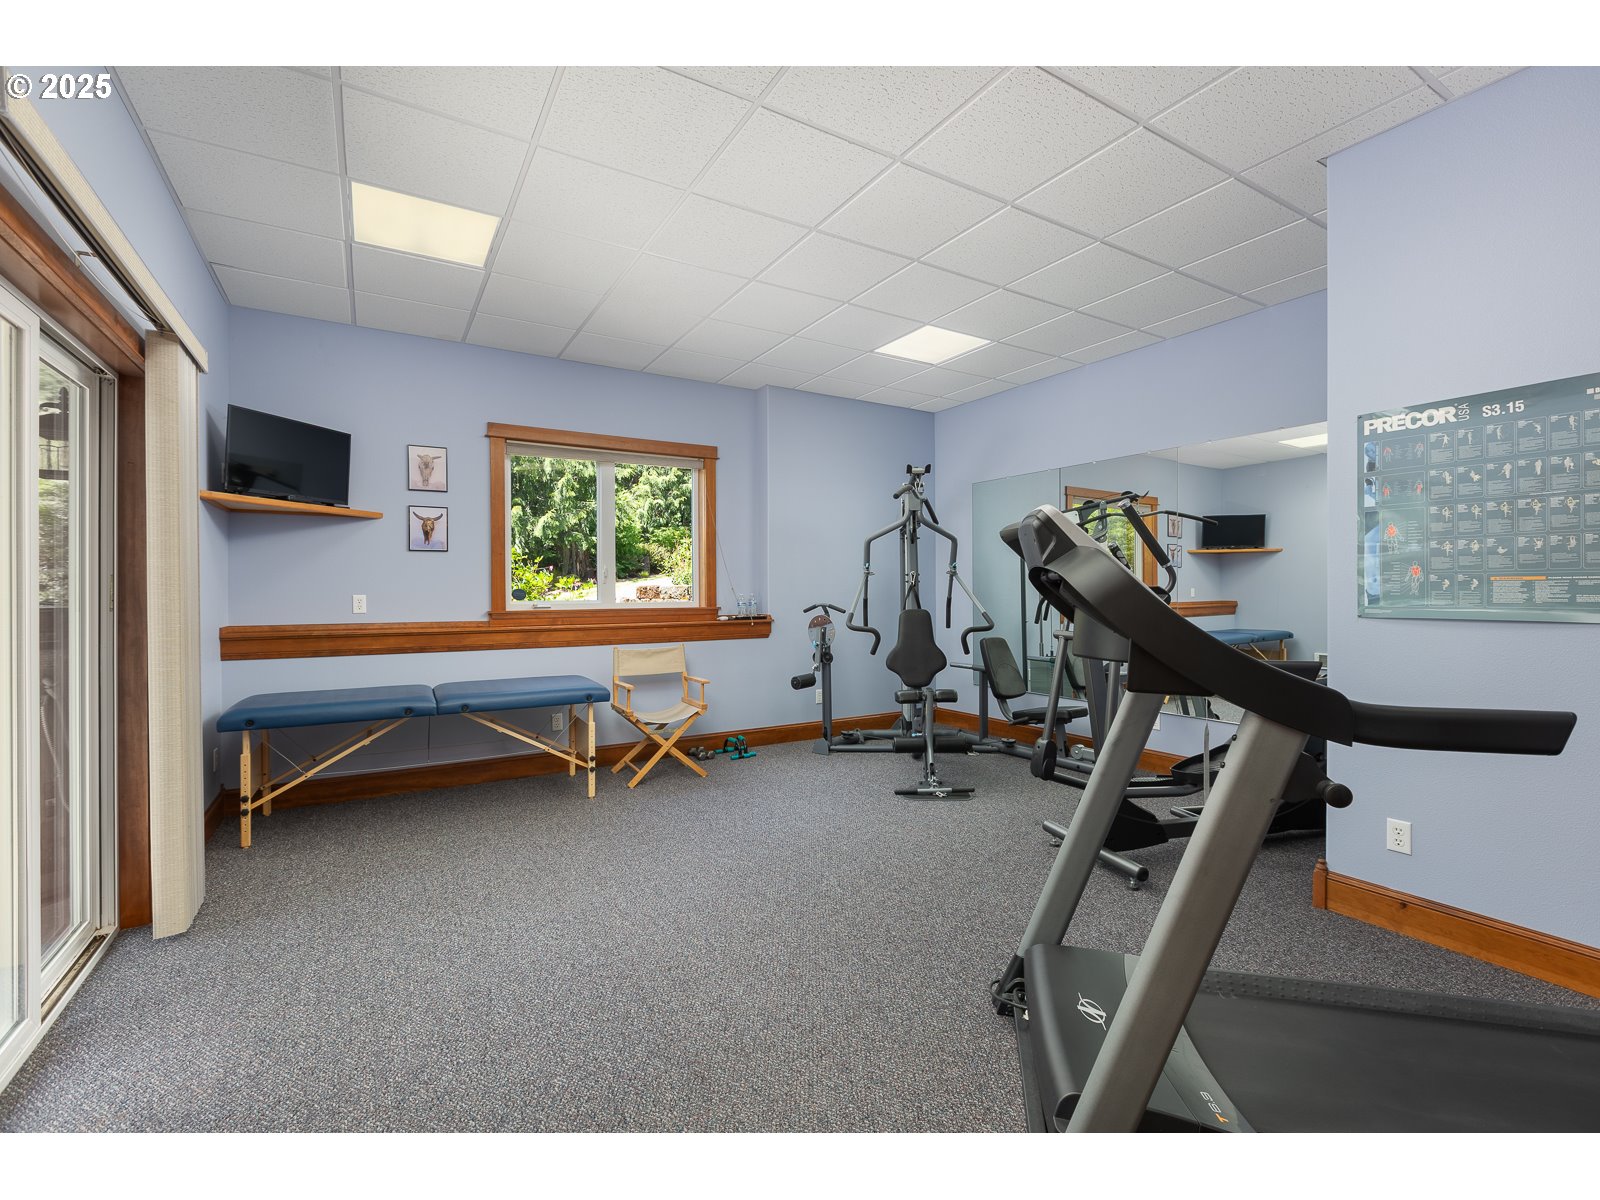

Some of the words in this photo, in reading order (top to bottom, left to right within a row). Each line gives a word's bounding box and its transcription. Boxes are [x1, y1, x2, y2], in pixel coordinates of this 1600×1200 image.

[1363, 406, 1457, 436] PRECOR
[1458, 402, 1470, 421] USA
[1482, 400, 1525, 417] S3.15
